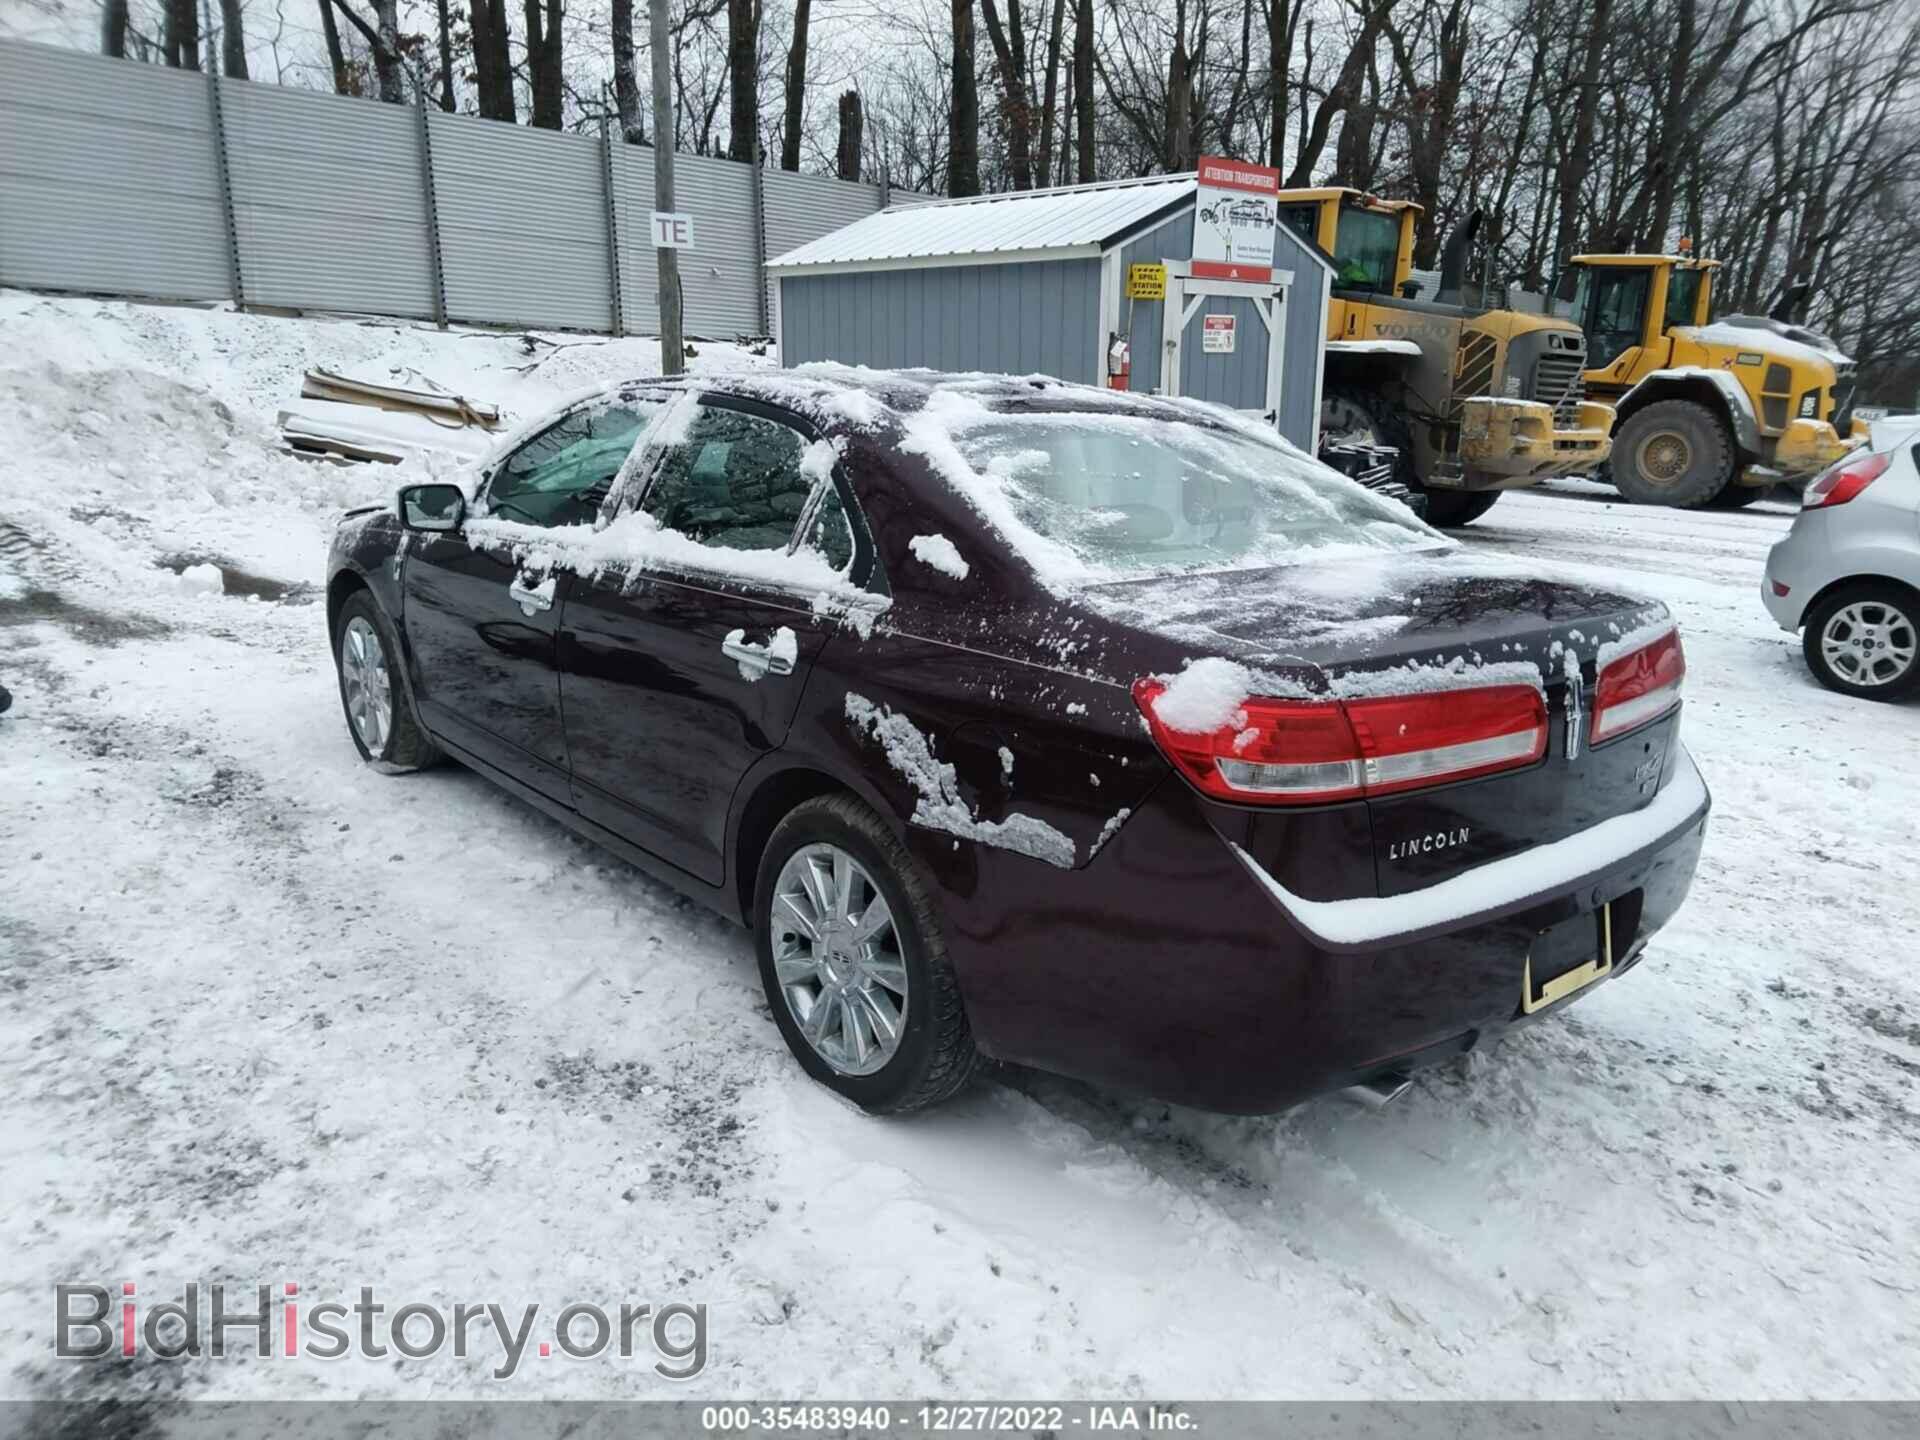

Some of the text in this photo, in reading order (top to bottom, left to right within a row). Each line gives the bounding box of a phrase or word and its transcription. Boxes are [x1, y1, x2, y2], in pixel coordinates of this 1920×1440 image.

[656, 219, 688, 243] TE
[1138, 273, 1158, 281] SPILL
[1373, 322, 1451, 338] VOLVO
[1389, 827, 1470, 860] LINCOLN
